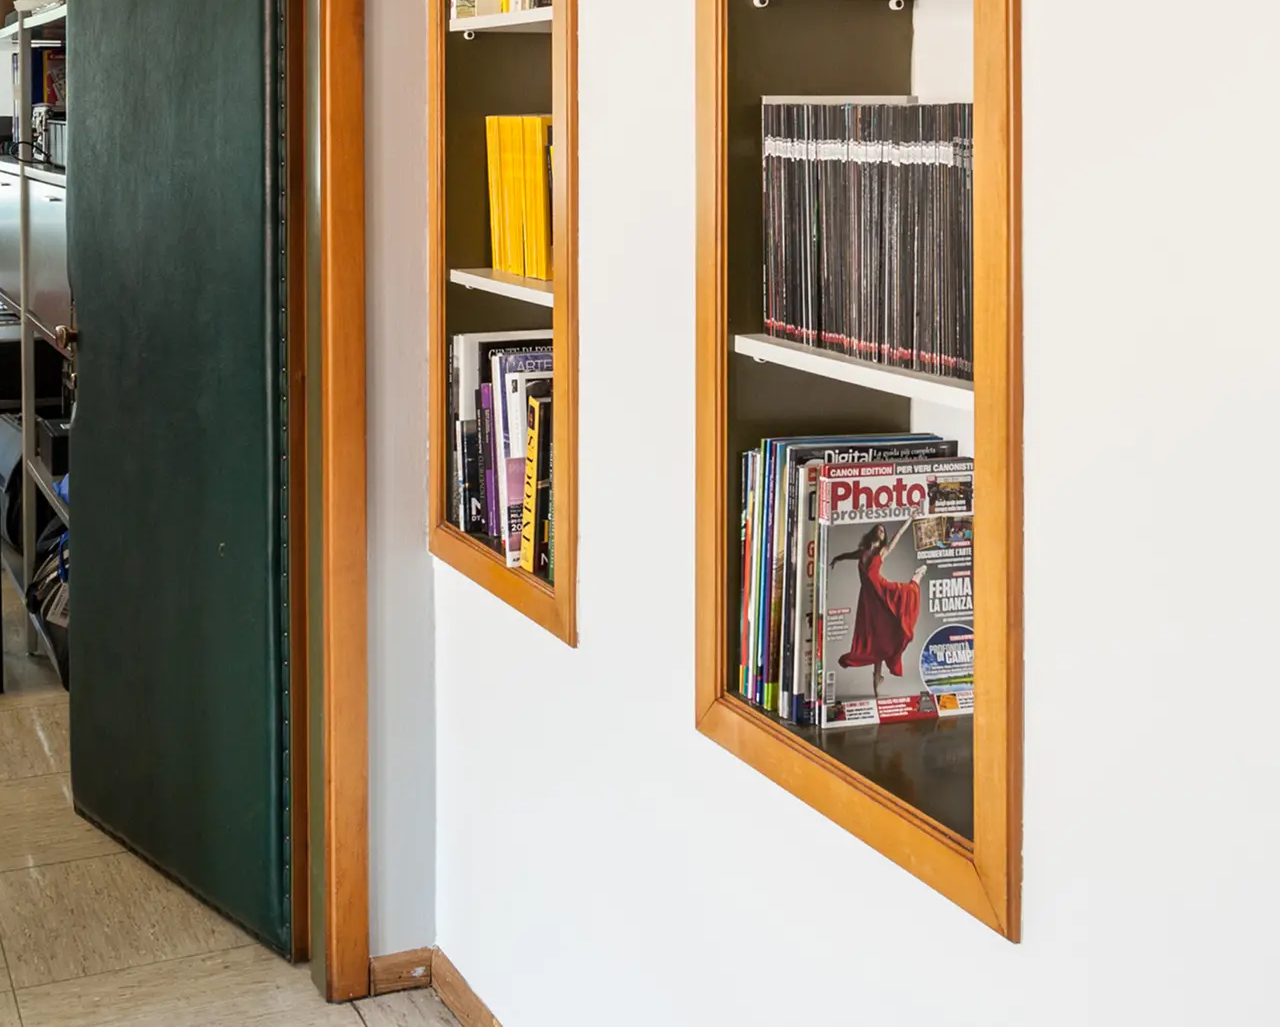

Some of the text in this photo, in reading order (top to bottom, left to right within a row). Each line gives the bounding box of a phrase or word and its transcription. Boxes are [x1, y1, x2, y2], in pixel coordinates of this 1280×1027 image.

[830, 467, 858, 477] CANON
[861, 465, 893, 475] EDITION
[897, 464, 912, 474] PER
[914, 464, 931, 473] VERI
[831, 477, 925, 511] Photo
[831, 497, 925, 523] professional
[929, 577, 972, 599] FERMA
[929, 597, 973, 613] LA DANZA
